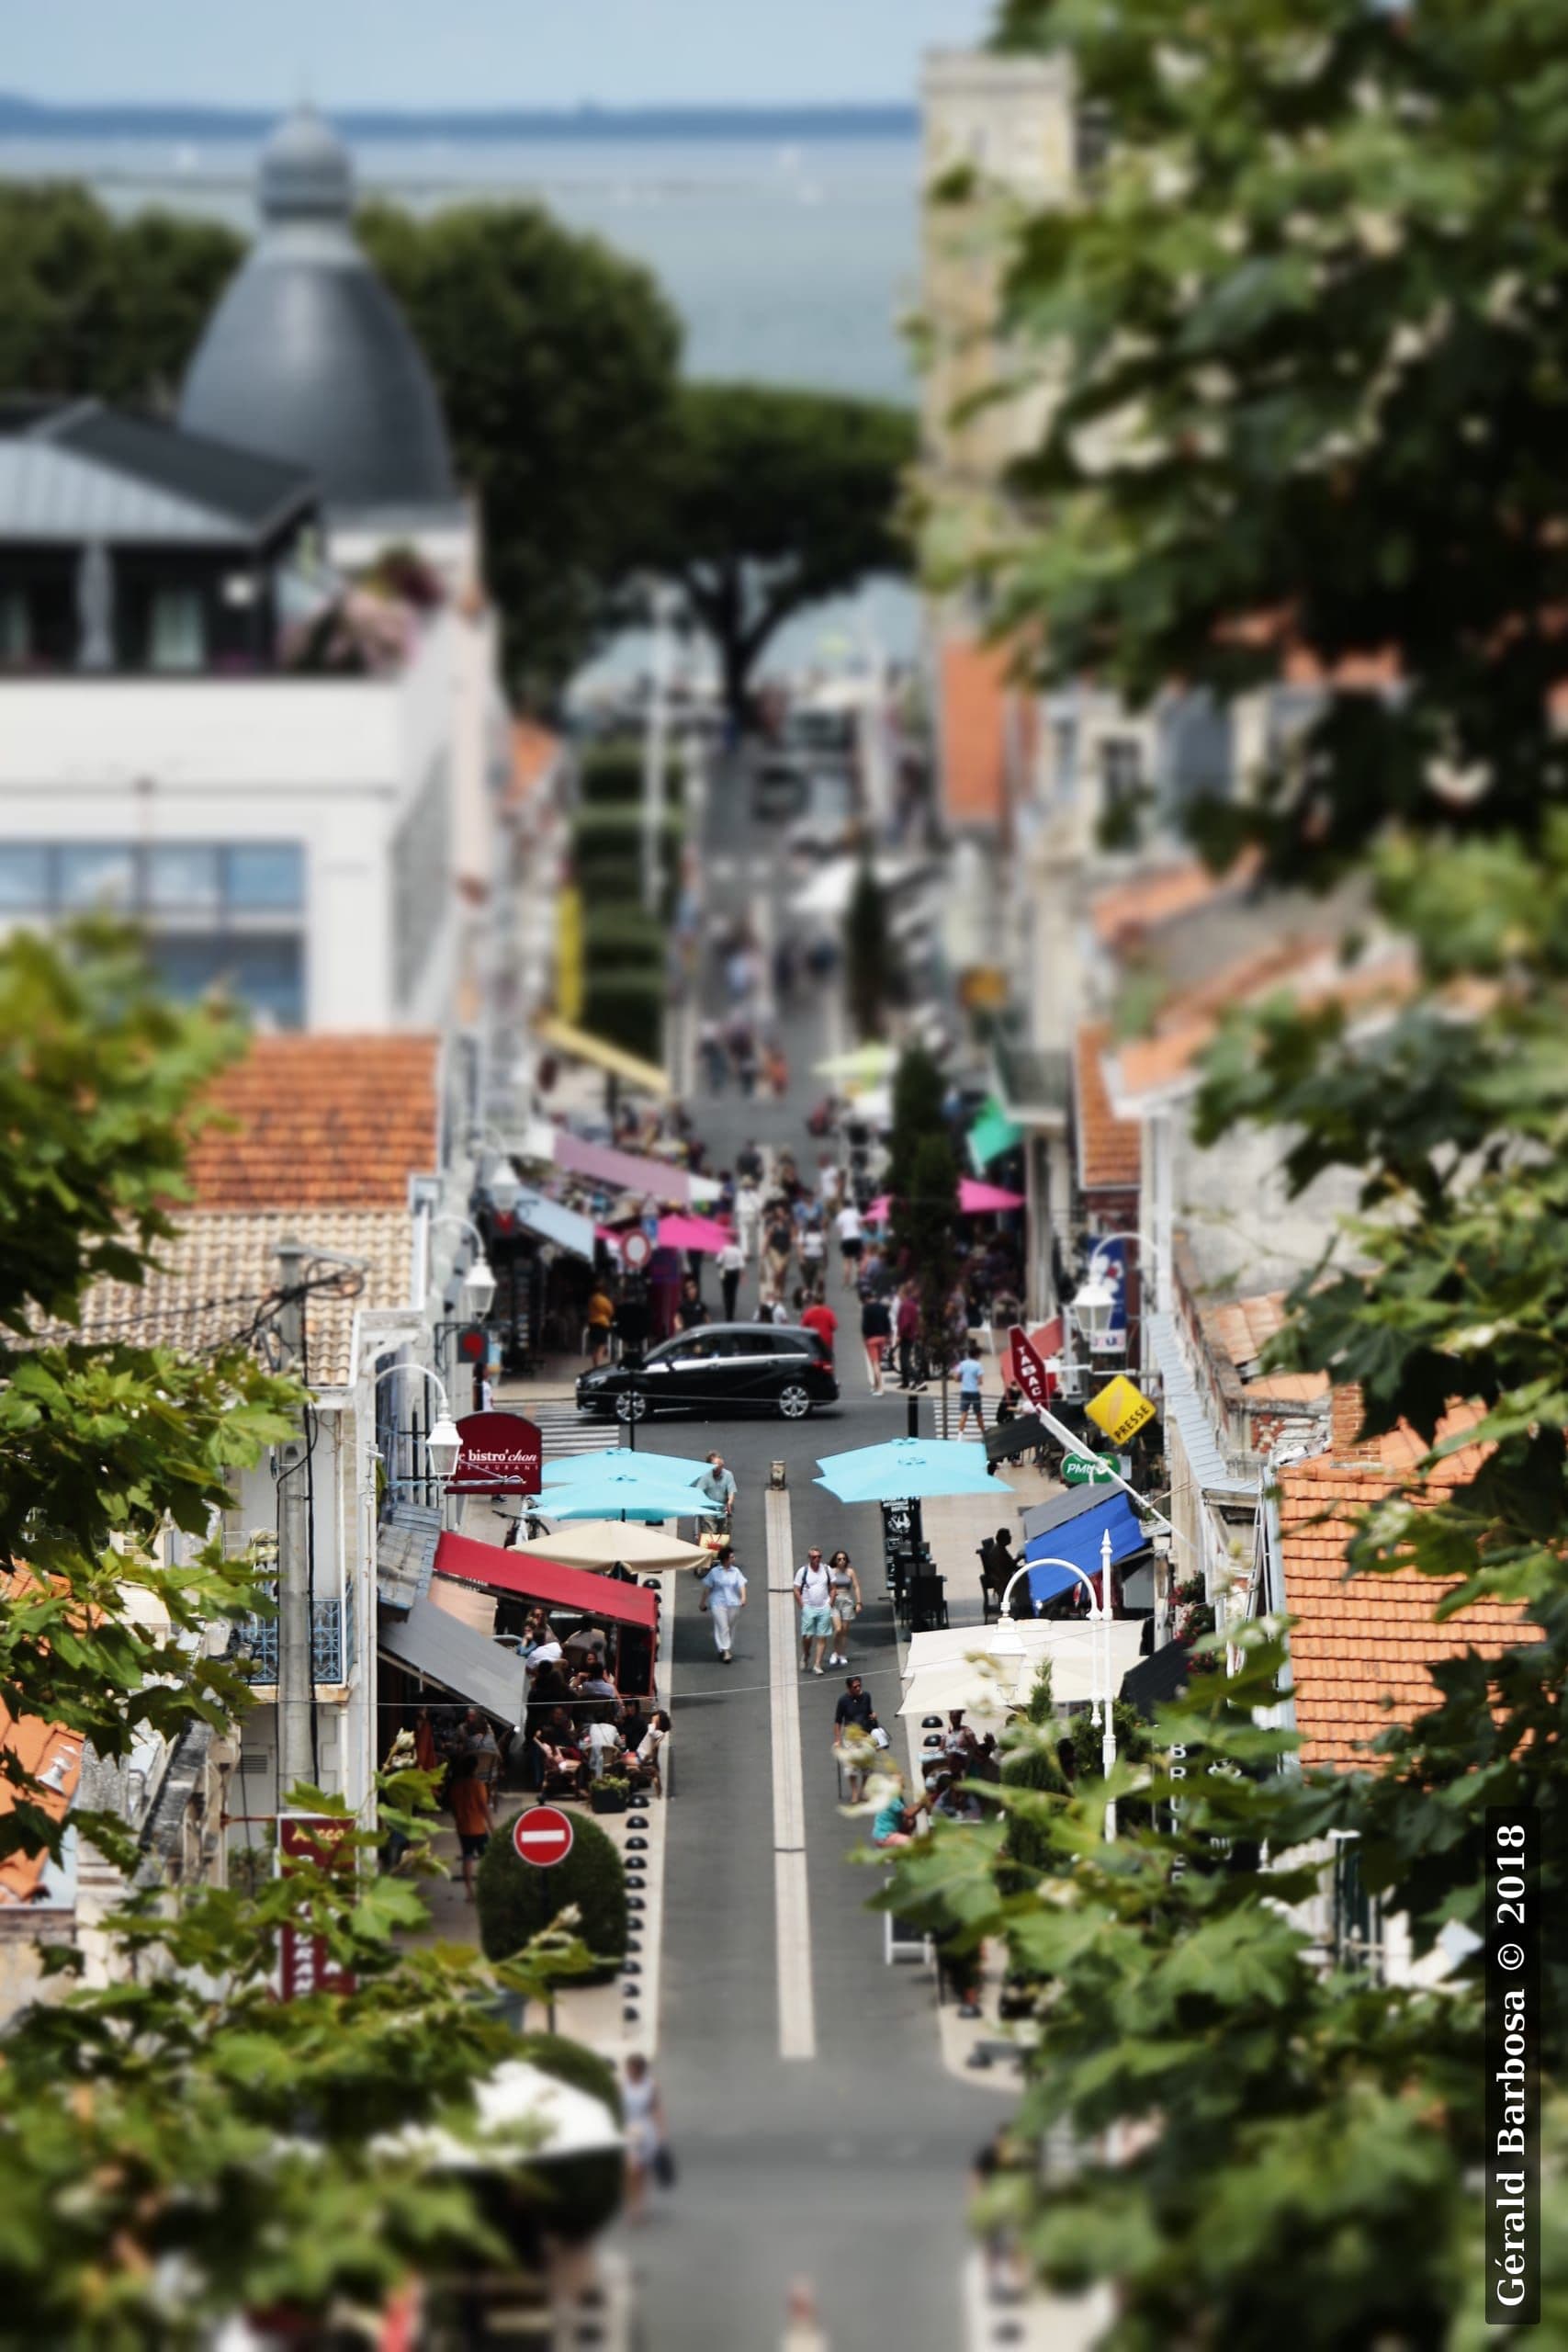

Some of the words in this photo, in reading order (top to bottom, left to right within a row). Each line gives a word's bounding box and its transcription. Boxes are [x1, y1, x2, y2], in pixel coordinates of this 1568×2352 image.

[1017, 1346, 1042, 1396] TABAC
[1113, 1404, 1149, 1440] PRESSE
[468, 1449, 537, 1462] bistro'chon
